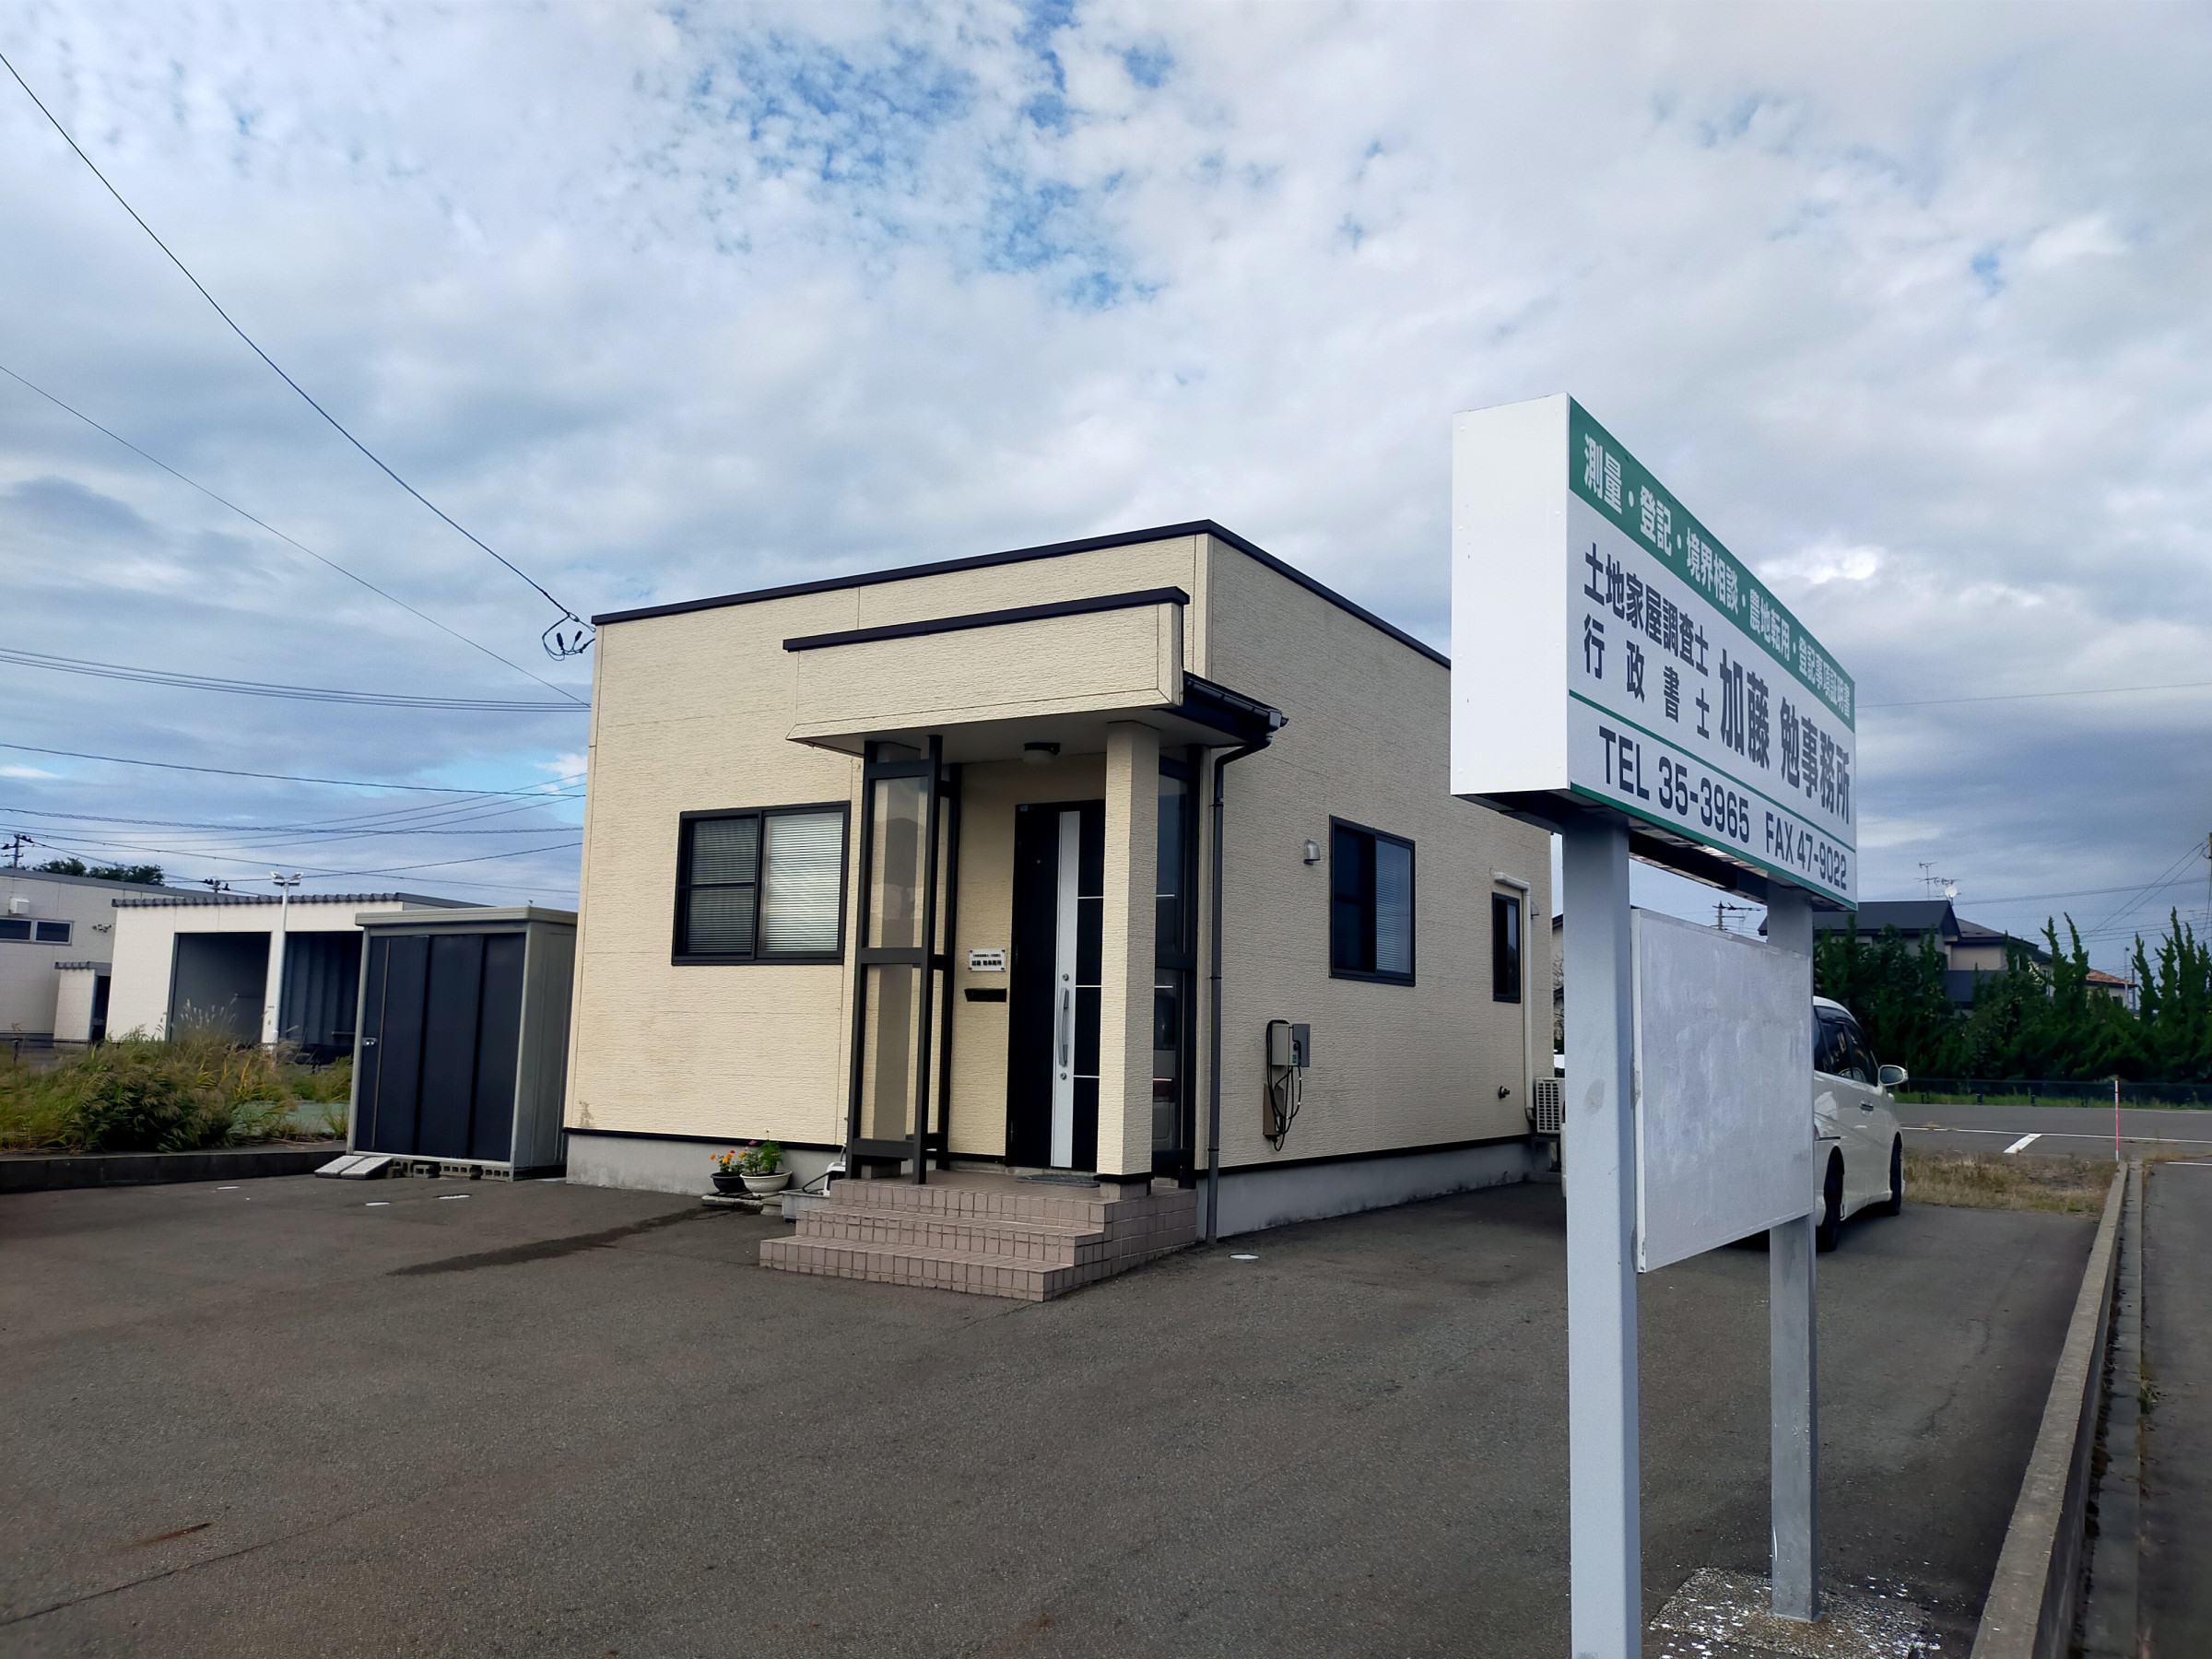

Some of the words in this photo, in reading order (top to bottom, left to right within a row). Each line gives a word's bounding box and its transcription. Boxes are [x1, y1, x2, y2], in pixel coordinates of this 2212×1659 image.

[1583, 542, 1709, 677] 土地家屋調査士
[1599, 725, 1650, 801] TEL
[1659, 756, 1749, 843] 35-3965
[1765, 811, 1794, 865] FAX
[1797, 830, 1847, 890] 47-9022
